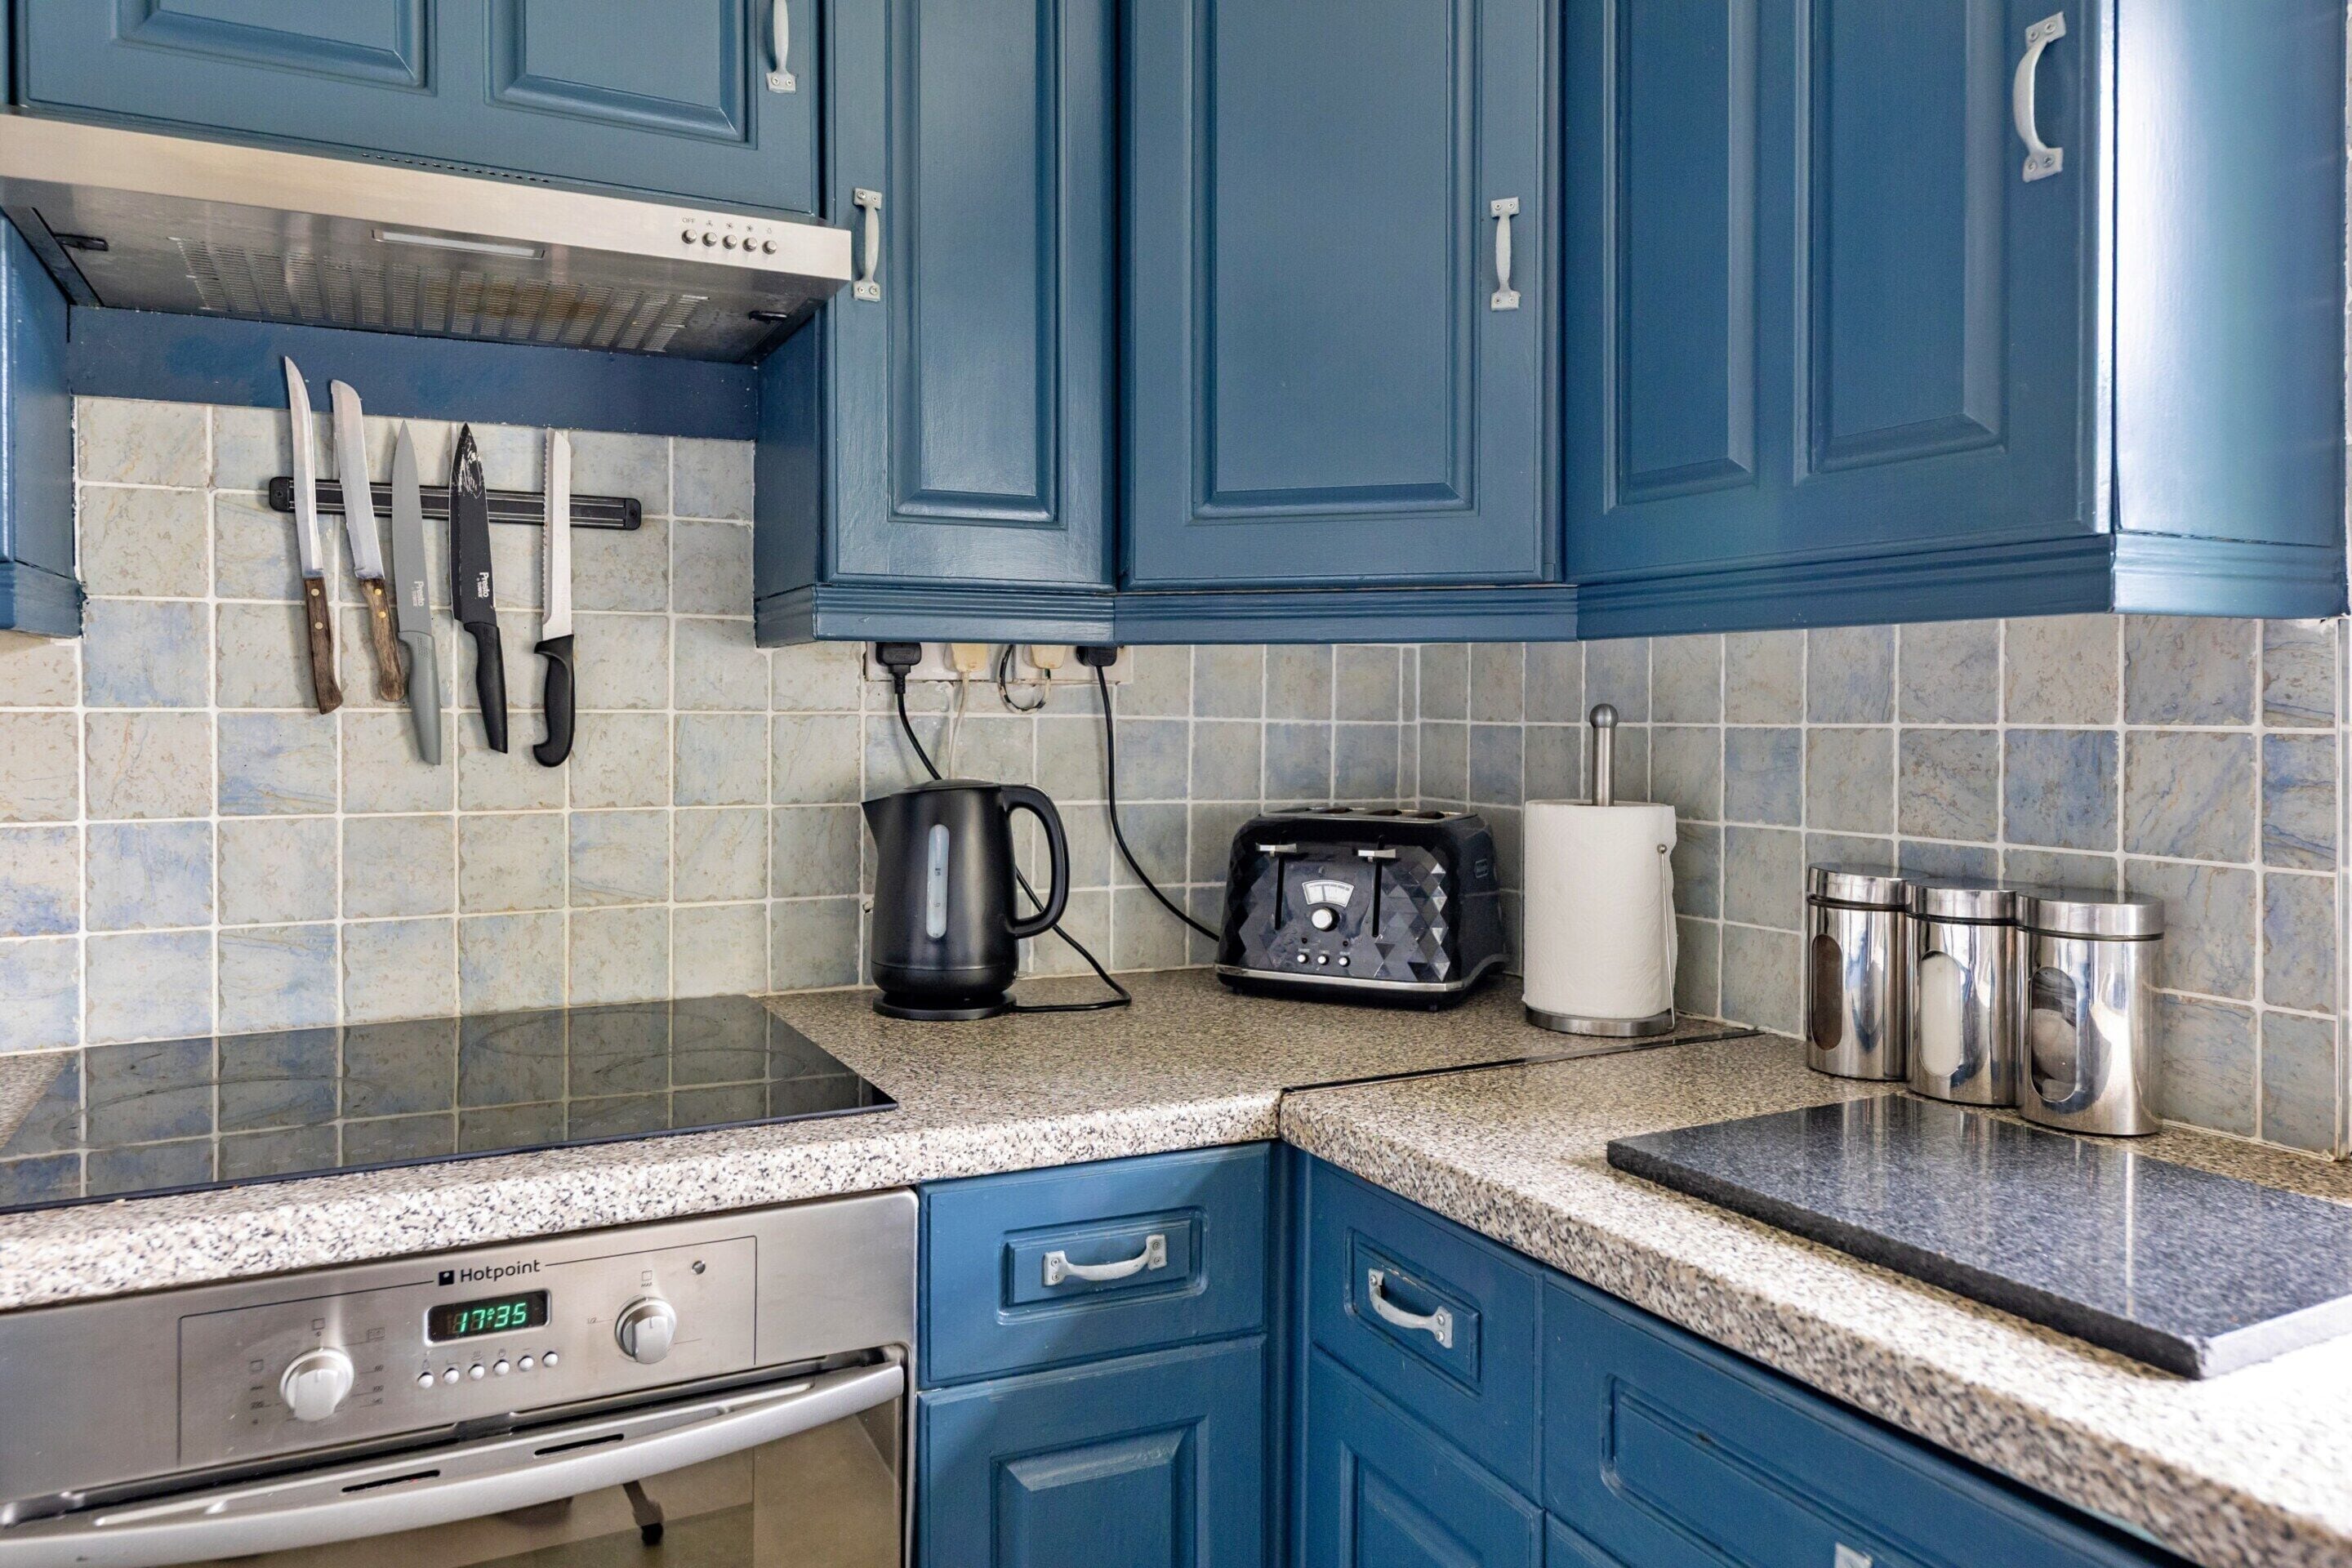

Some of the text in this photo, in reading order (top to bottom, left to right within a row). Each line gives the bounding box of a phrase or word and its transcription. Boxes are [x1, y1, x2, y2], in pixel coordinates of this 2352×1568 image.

[414, 581, 425, 607] Presto
[479, 572, 490, 598] Presto
[461, 1259, 541, 1282] Hotpoint
[459, 1302, 527, 1333] 17:35
